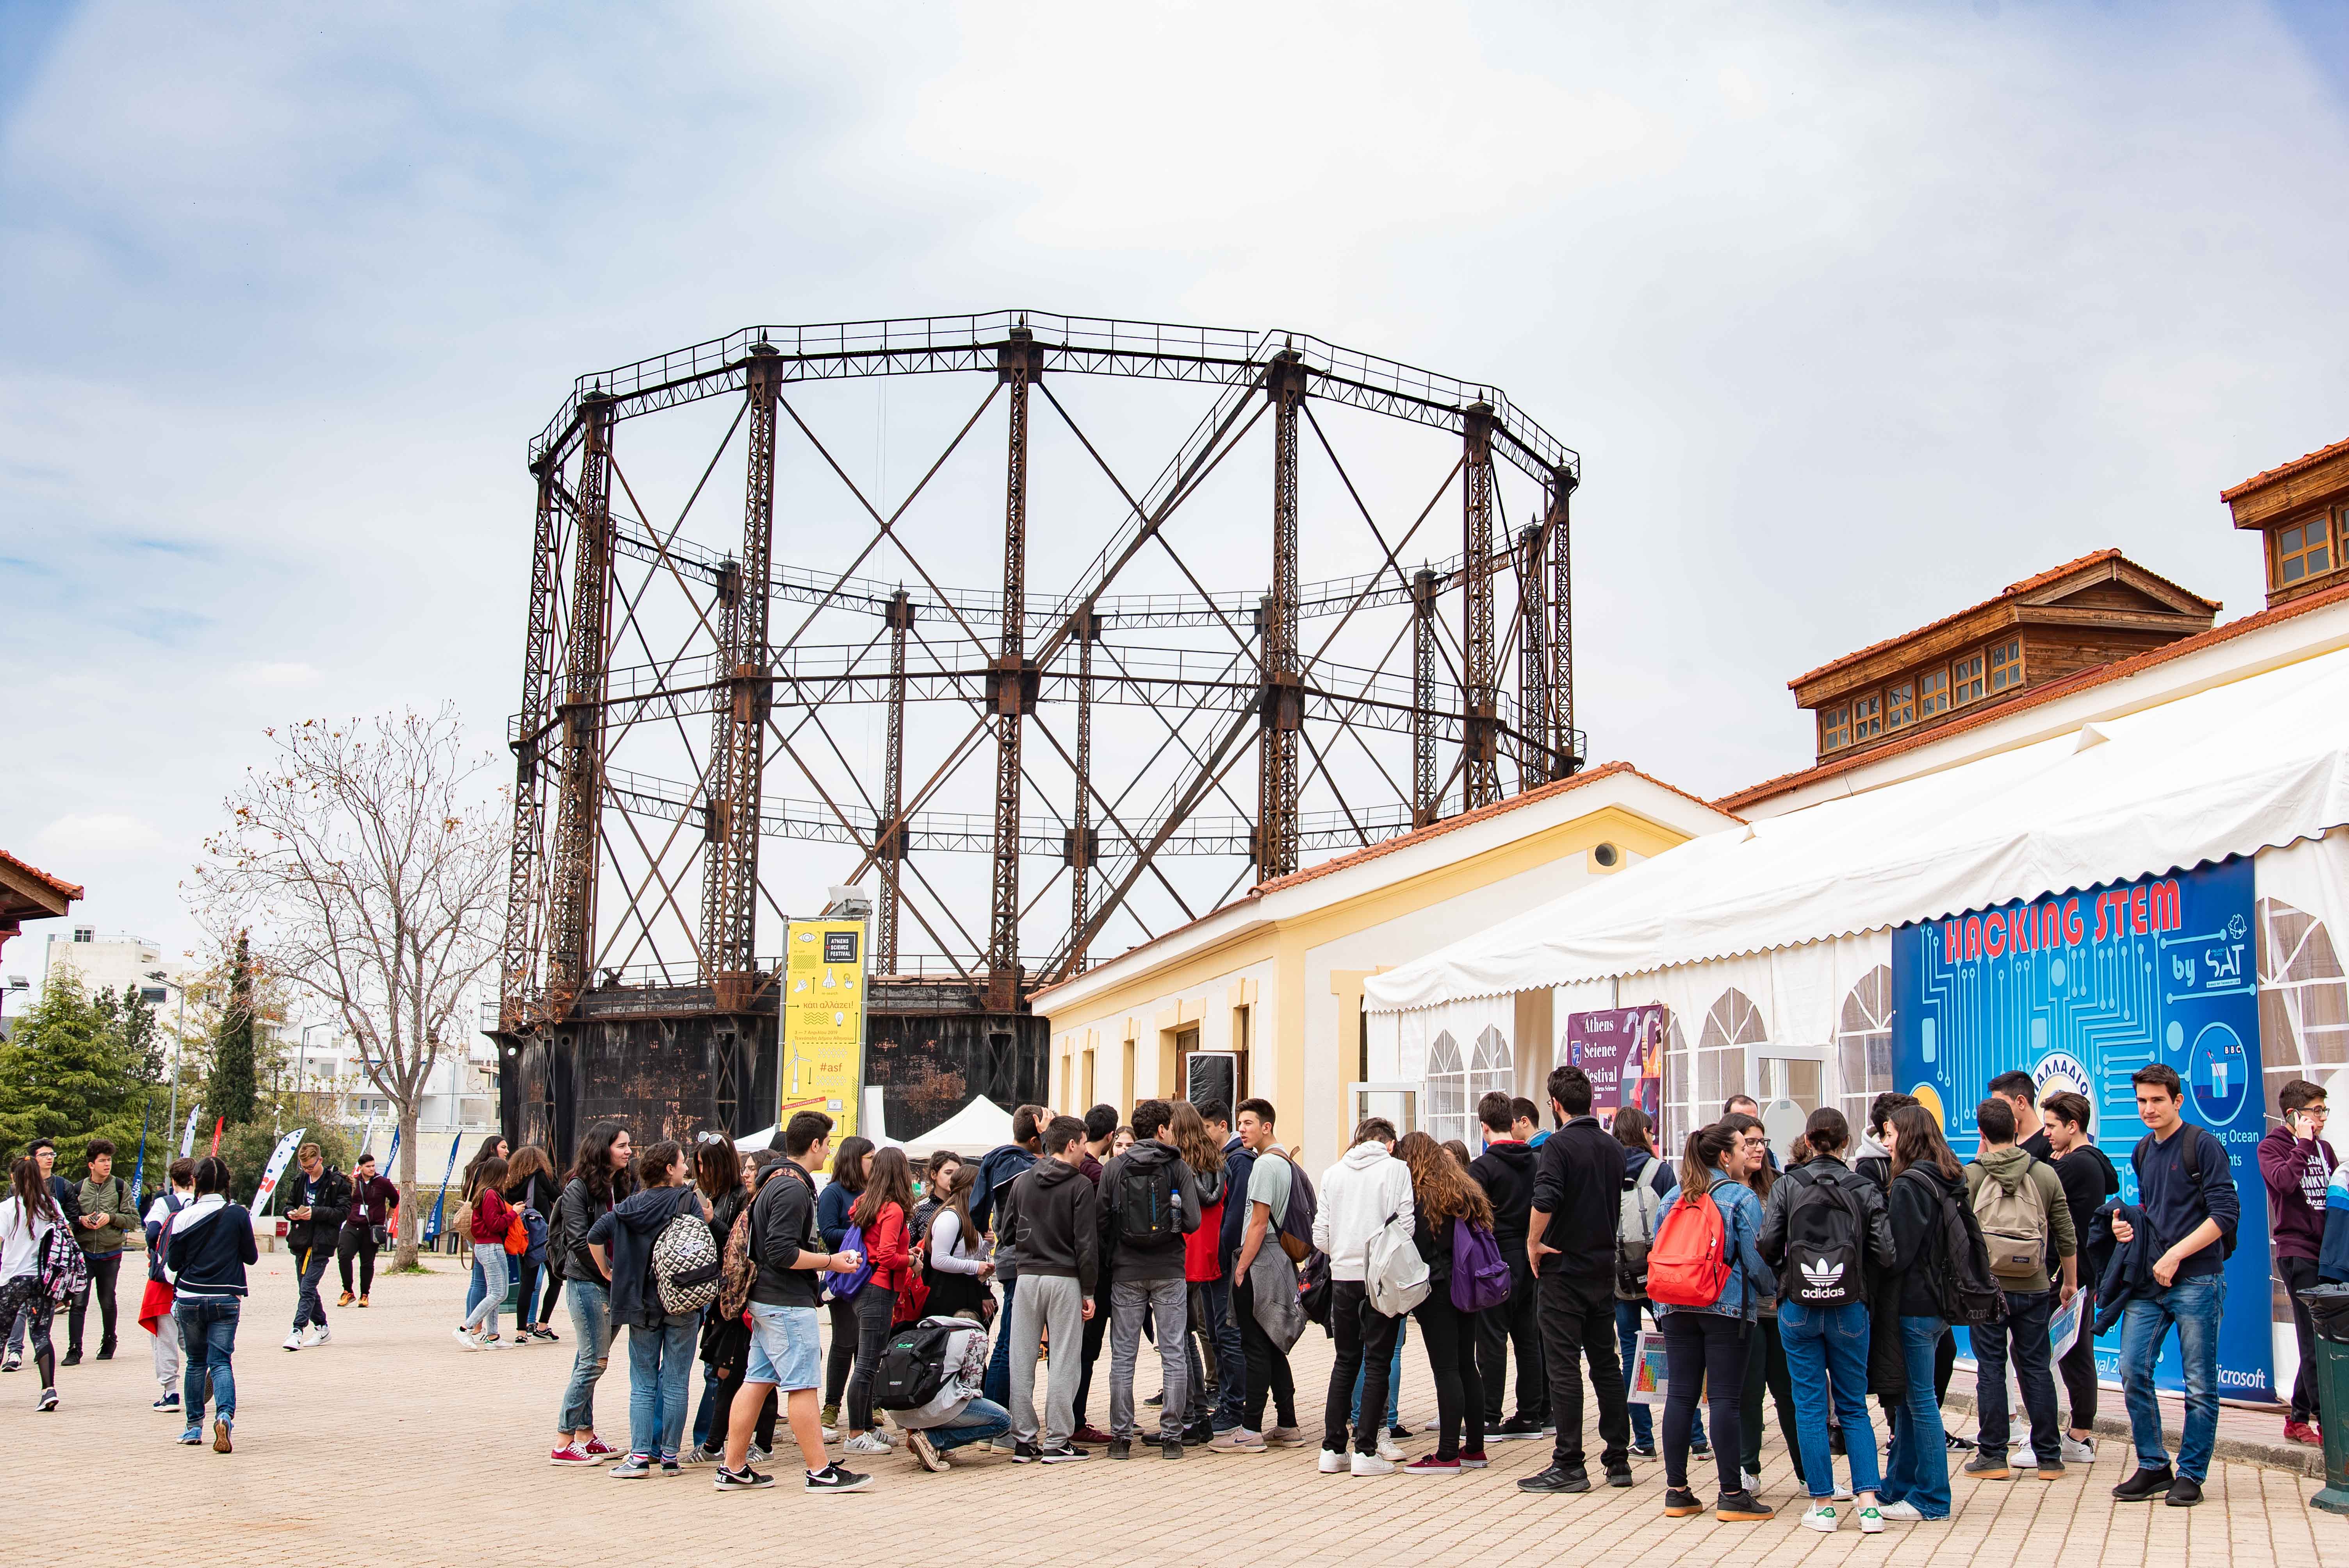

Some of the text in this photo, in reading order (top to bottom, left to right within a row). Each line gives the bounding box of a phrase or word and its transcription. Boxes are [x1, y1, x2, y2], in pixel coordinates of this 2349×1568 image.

[1945, 878, 2181, 964] HACKING STEM
[2172, 944, 2244, 987] by SAT
[820, 1001, 853, 1009] αλλάζει!
[1584, 1016, 1614, 1033] Athens
[1584, 1042, 1617, 1058] Science
[820, 1062, 843, 1072] #asf
[2229, 1129, 2259, 1142] Ocean
[1801, 1287, 1845, 1299] adidas
